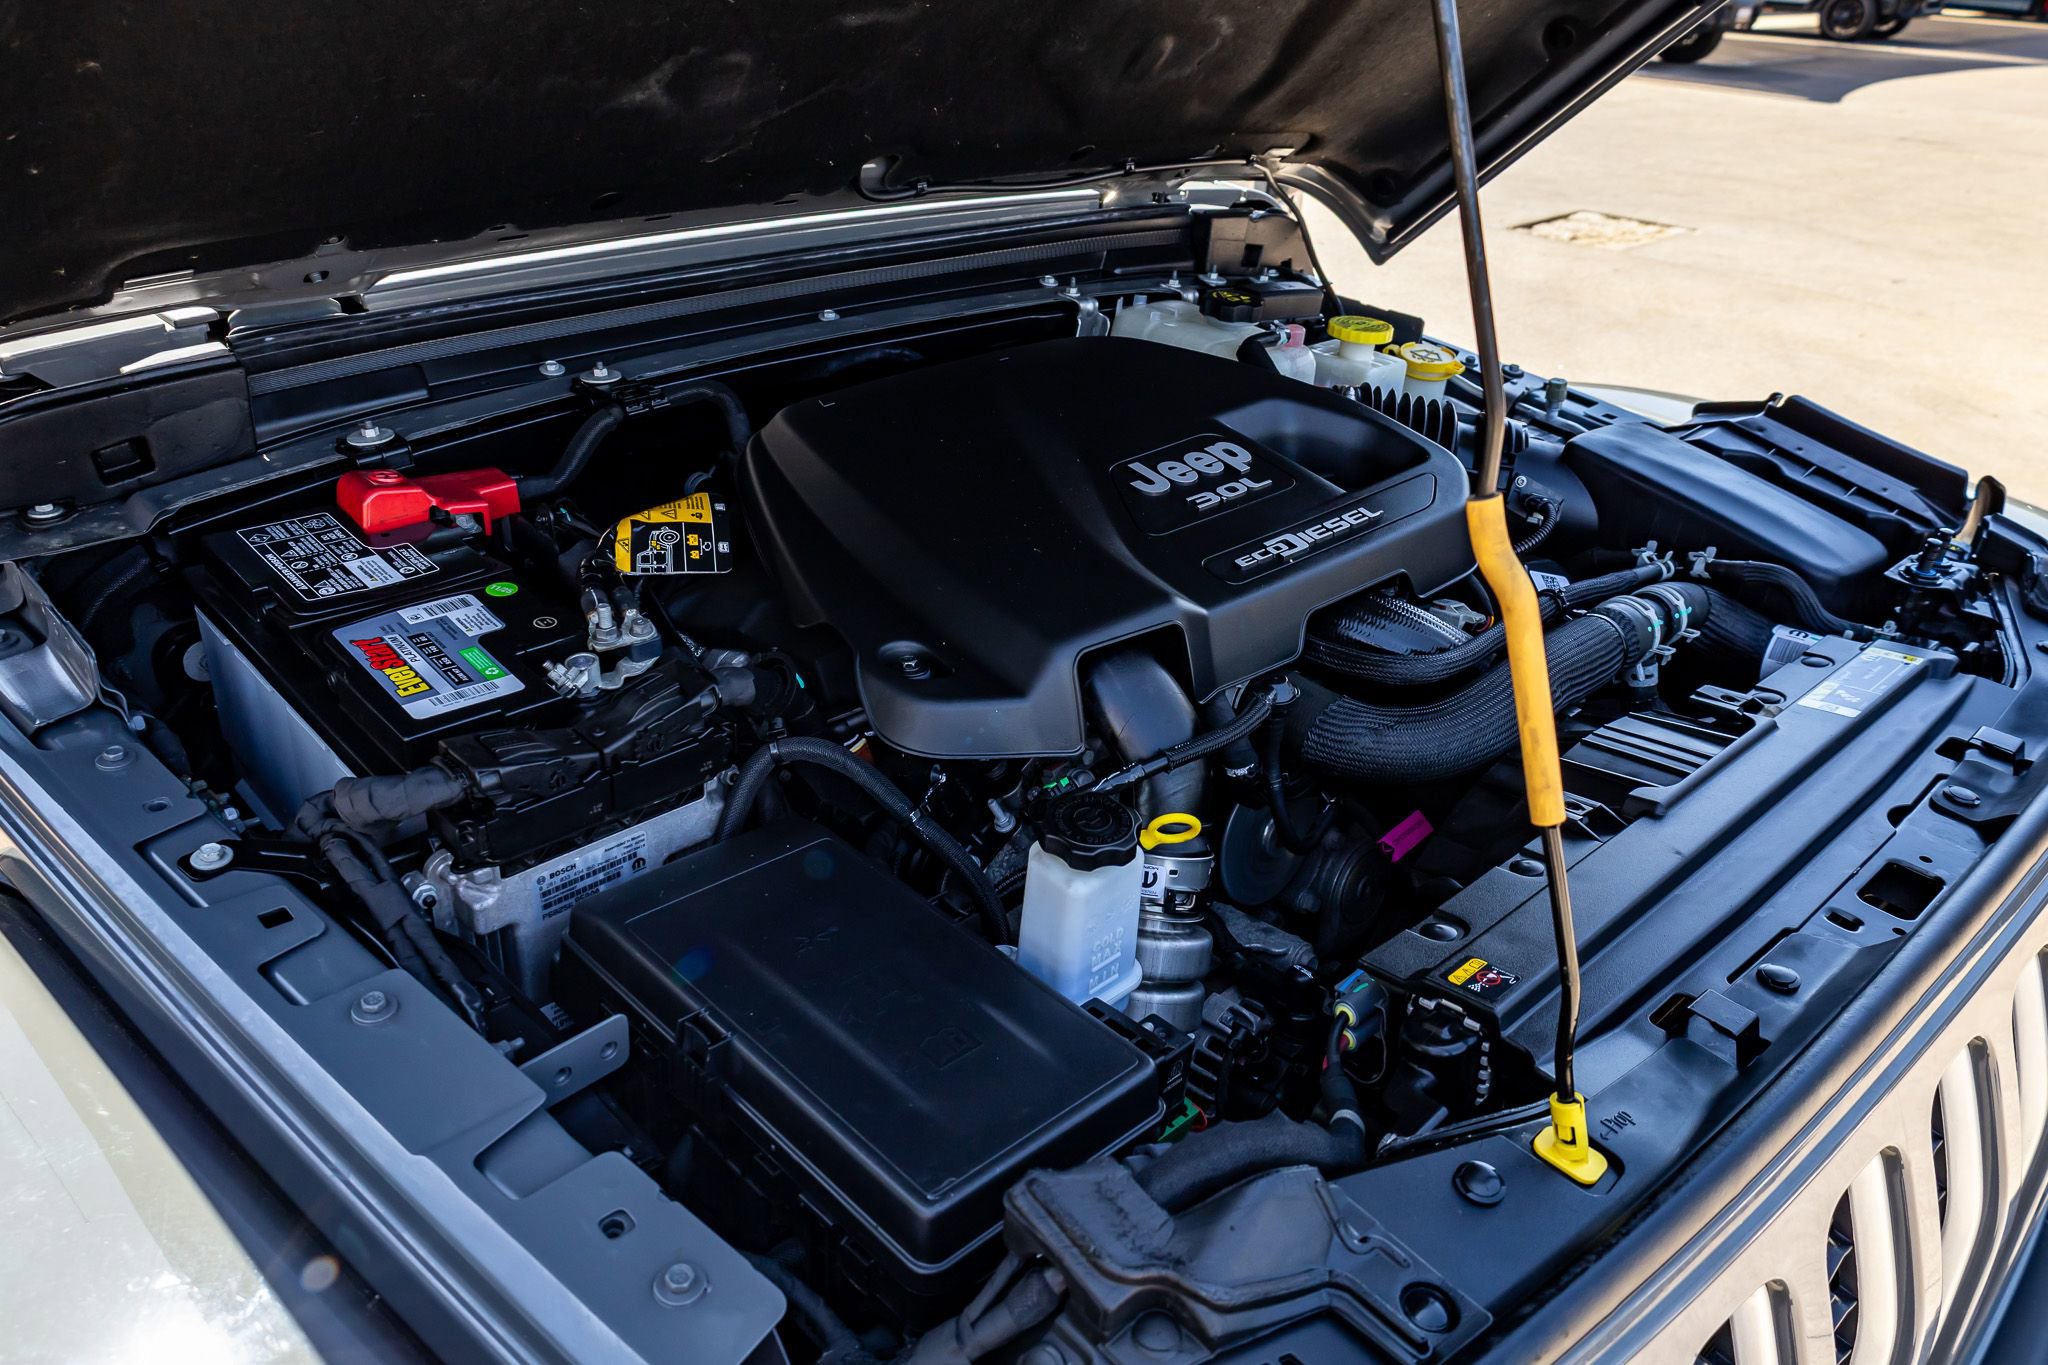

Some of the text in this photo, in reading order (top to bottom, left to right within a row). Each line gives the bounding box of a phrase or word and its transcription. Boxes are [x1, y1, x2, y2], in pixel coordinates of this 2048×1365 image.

[1128, 441, 1252, 495] Jeep
[1186, 477, 1272, 509] 3.0L
[387, 636, 419, 663] PLATINUM
[349, 636, 433, 698] EverStart
[549, 862, 576, 879] BOSCH
[1092, 940, 1122, 968] MAX
[1093, 927, 1124, 953] COLD
[1089, 962, 1119, 990] MIN
[1600, 1111, 1636, 1134] Prop
